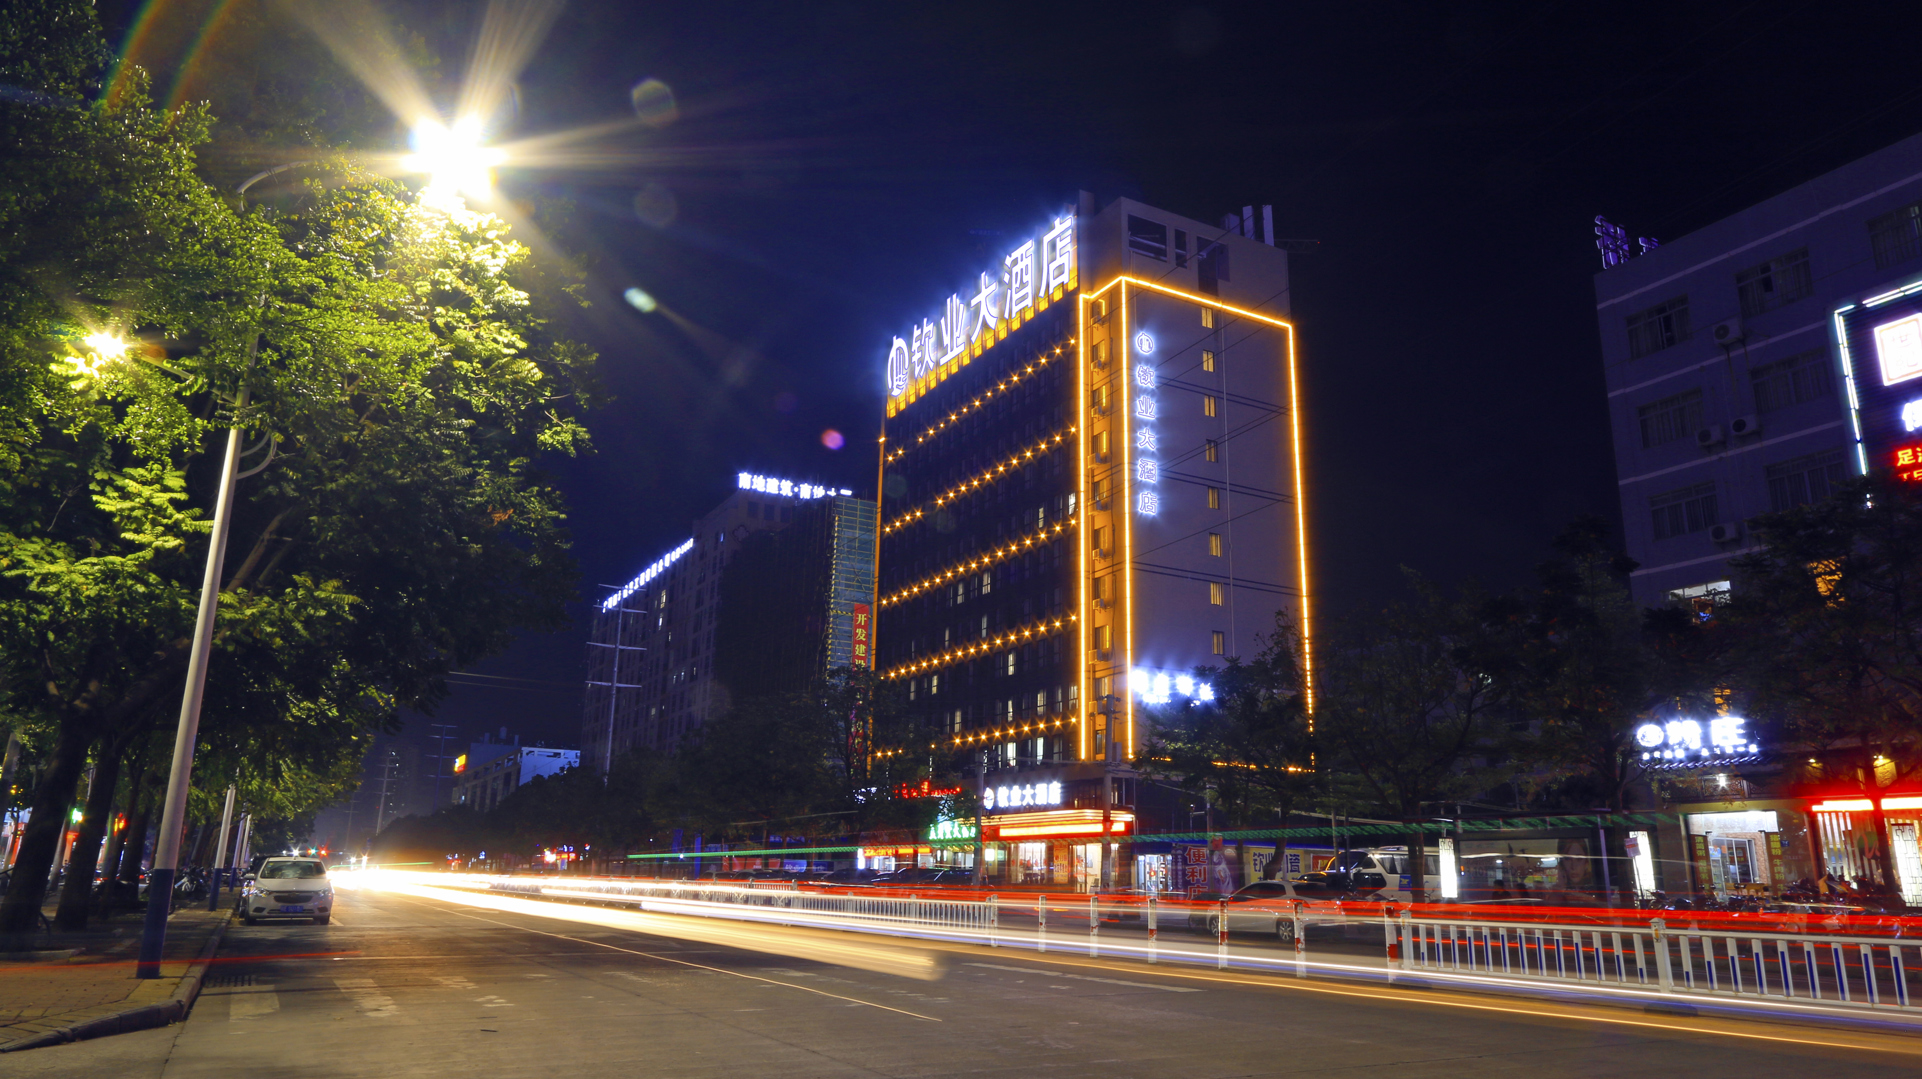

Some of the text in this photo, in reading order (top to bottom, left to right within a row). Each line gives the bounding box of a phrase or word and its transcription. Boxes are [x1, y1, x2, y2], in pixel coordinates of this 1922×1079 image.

[911, 215, 1075, 380] 钦业大酒店
[1137, 365, 1158, 515] 钦业大酒店
[997, 781, 1062, 808] 钦业大酒店
